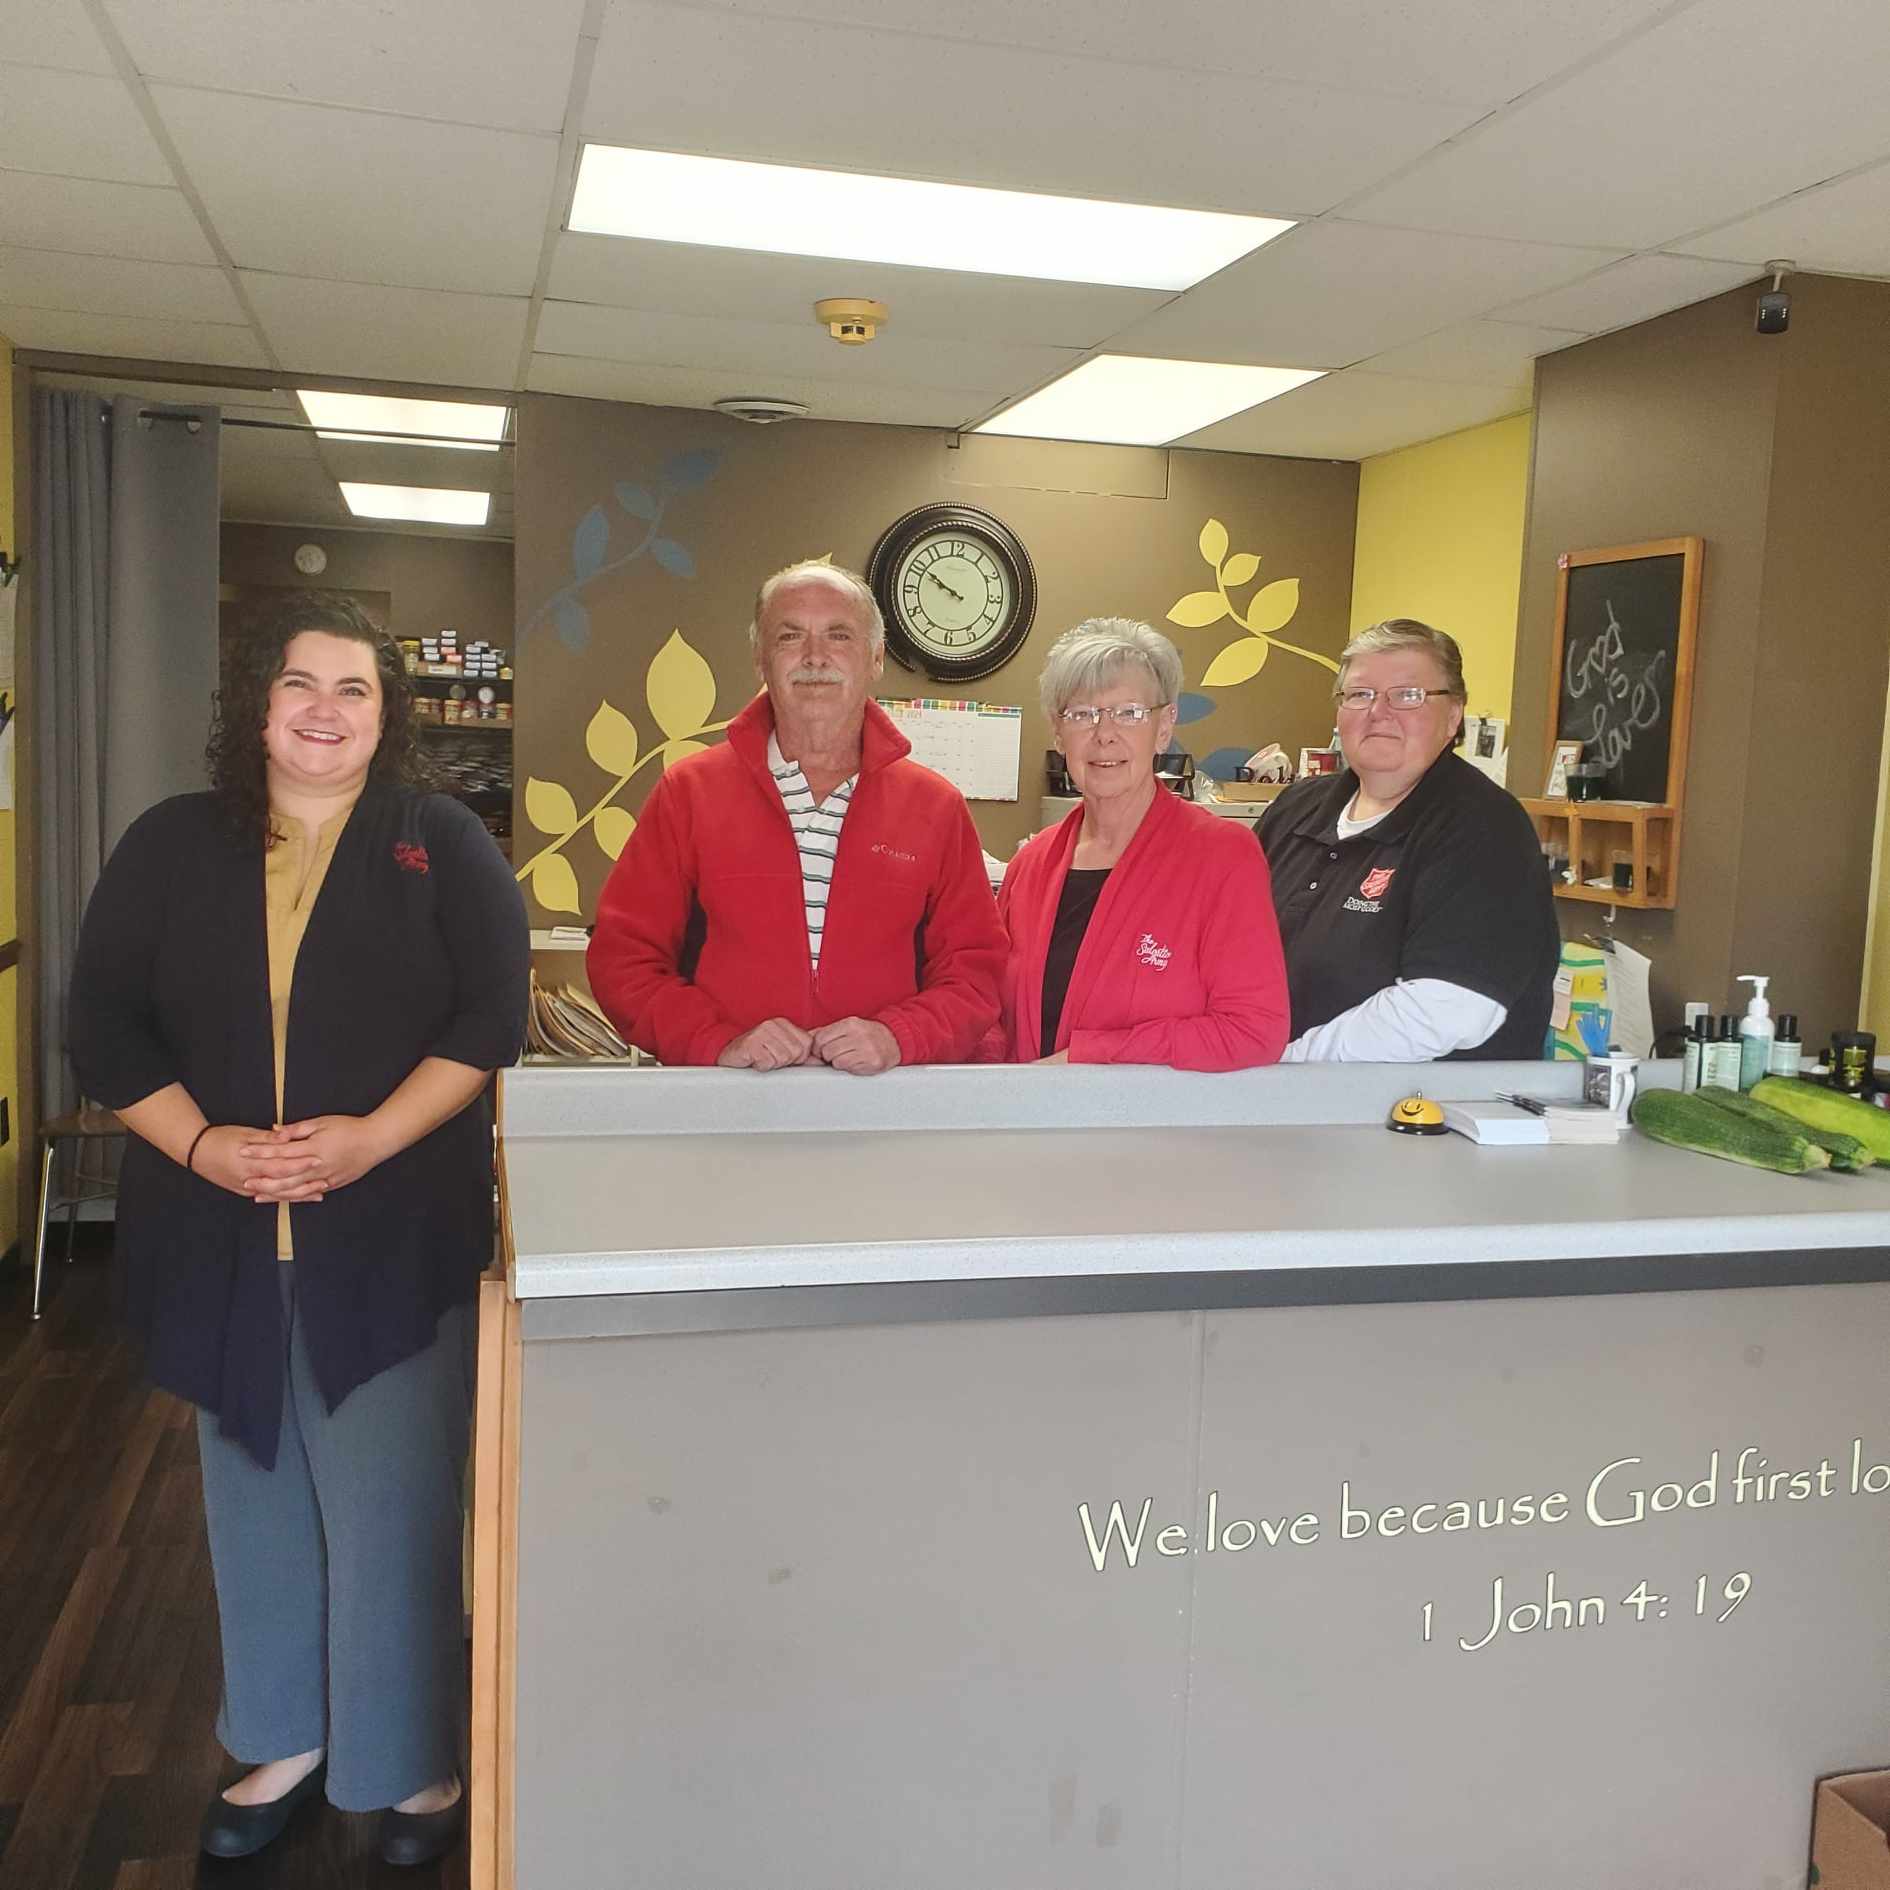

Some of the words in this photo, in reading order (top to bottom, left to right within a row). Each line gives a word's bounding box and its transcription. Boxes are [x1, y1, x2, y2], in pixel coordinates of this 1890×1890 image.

[926, 544, 940, 561] 11
[950, 541, 965, 558] 12
[909, 560, 927, 577] 10
[984, 571, 1000, 584] 2
[904, 584, 919, 594] 9
[988, 594, 1002, 605] 3
[907, 605, 922, 618] 8
[923, 619, 936, 636] 7
[966, 625, 977, 641] 5
[943, 631, 953, 646] 6
[1567, 600, 1625, 698] God
[1604, 667, 1629, 706] is
[1078, 1497, 1189, 1573] We
[1206, 1490, 1320, 1552] love
[1340, 1480, 1570, 1540] because
[1584, 1449, 1720, 1528] God
[1731, 1446, 1838, 1504] first
[1422, 1601, 1434, 1642] 1
[1458, 1571, 1606, 1652] John
[1620, 1579, 1670, 1622] 4:
[1695, 1571, 1752, 1624] 19
